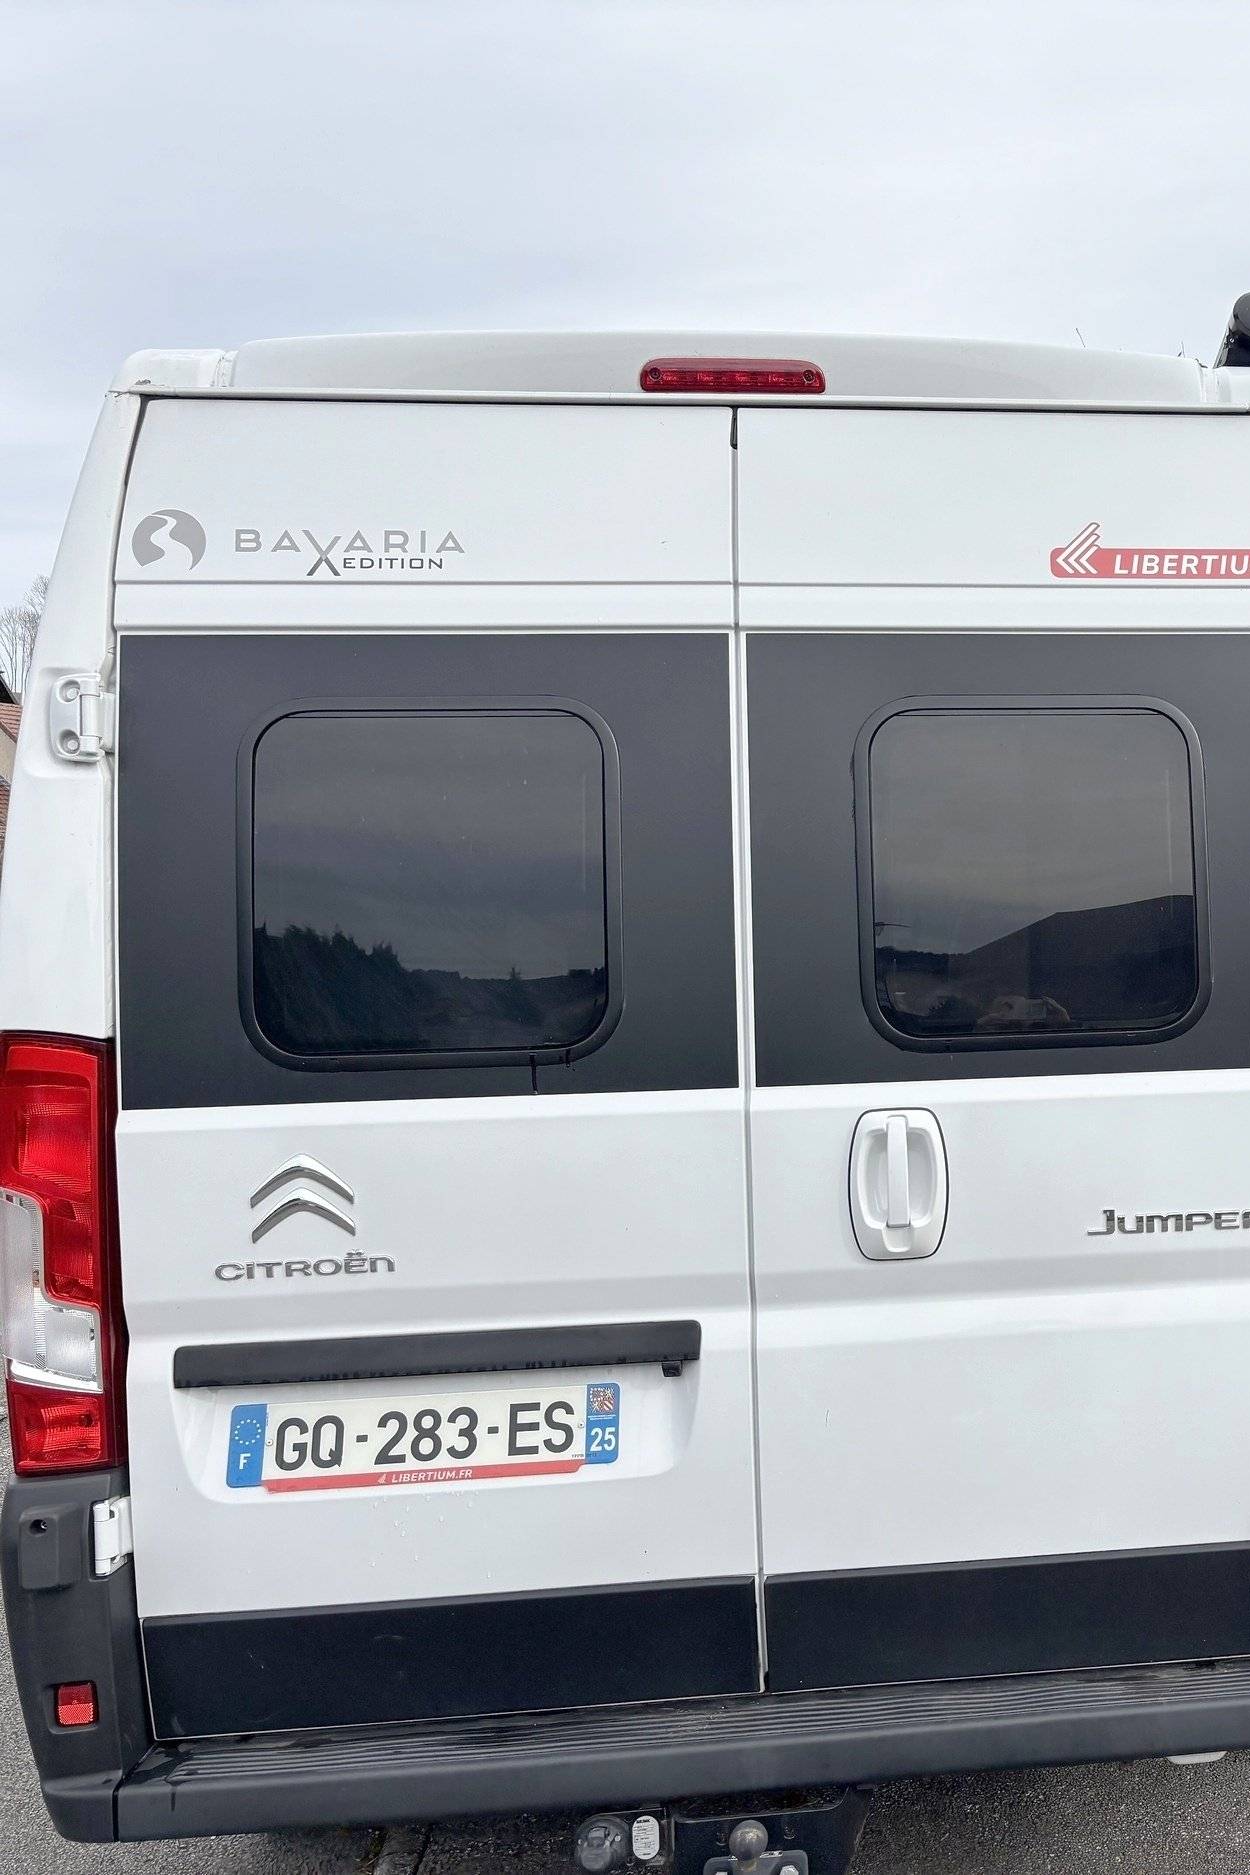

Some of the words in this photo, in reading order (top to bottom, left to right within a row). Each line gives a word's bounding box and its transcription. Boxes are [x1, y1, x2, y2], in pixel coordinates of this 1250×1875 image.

[274, 1400, 575, 1472] GQ-283-ES
[590, 1427, 616, 1452] 25
[239, 1453, 251, 1471] F
[391, 1468, 473, 1483] LIBERTIUM.FR
